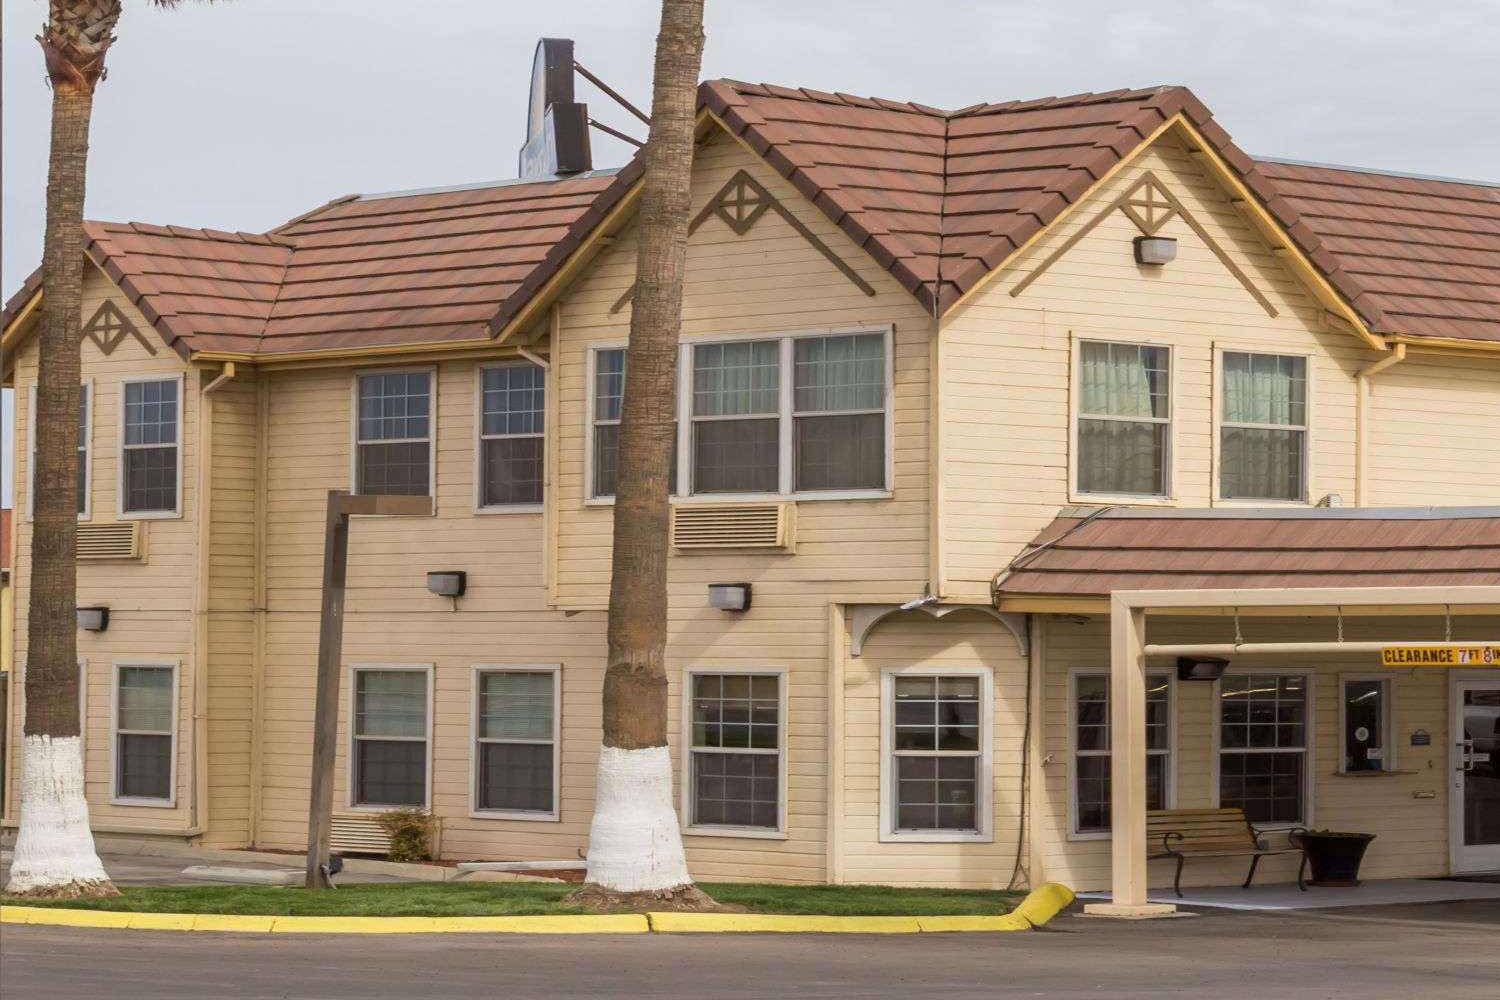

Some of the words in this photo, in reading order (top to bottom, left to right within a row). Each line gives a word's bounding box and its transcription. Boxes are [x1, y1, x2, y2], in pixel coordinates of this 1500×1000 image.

[1384, 649, 1453, 663] CLEARANCE
[1458, 649, 1468, 663] 7
[1469, 649, 1480, 660] FT
[1483, 646, 1493, 663] 8
